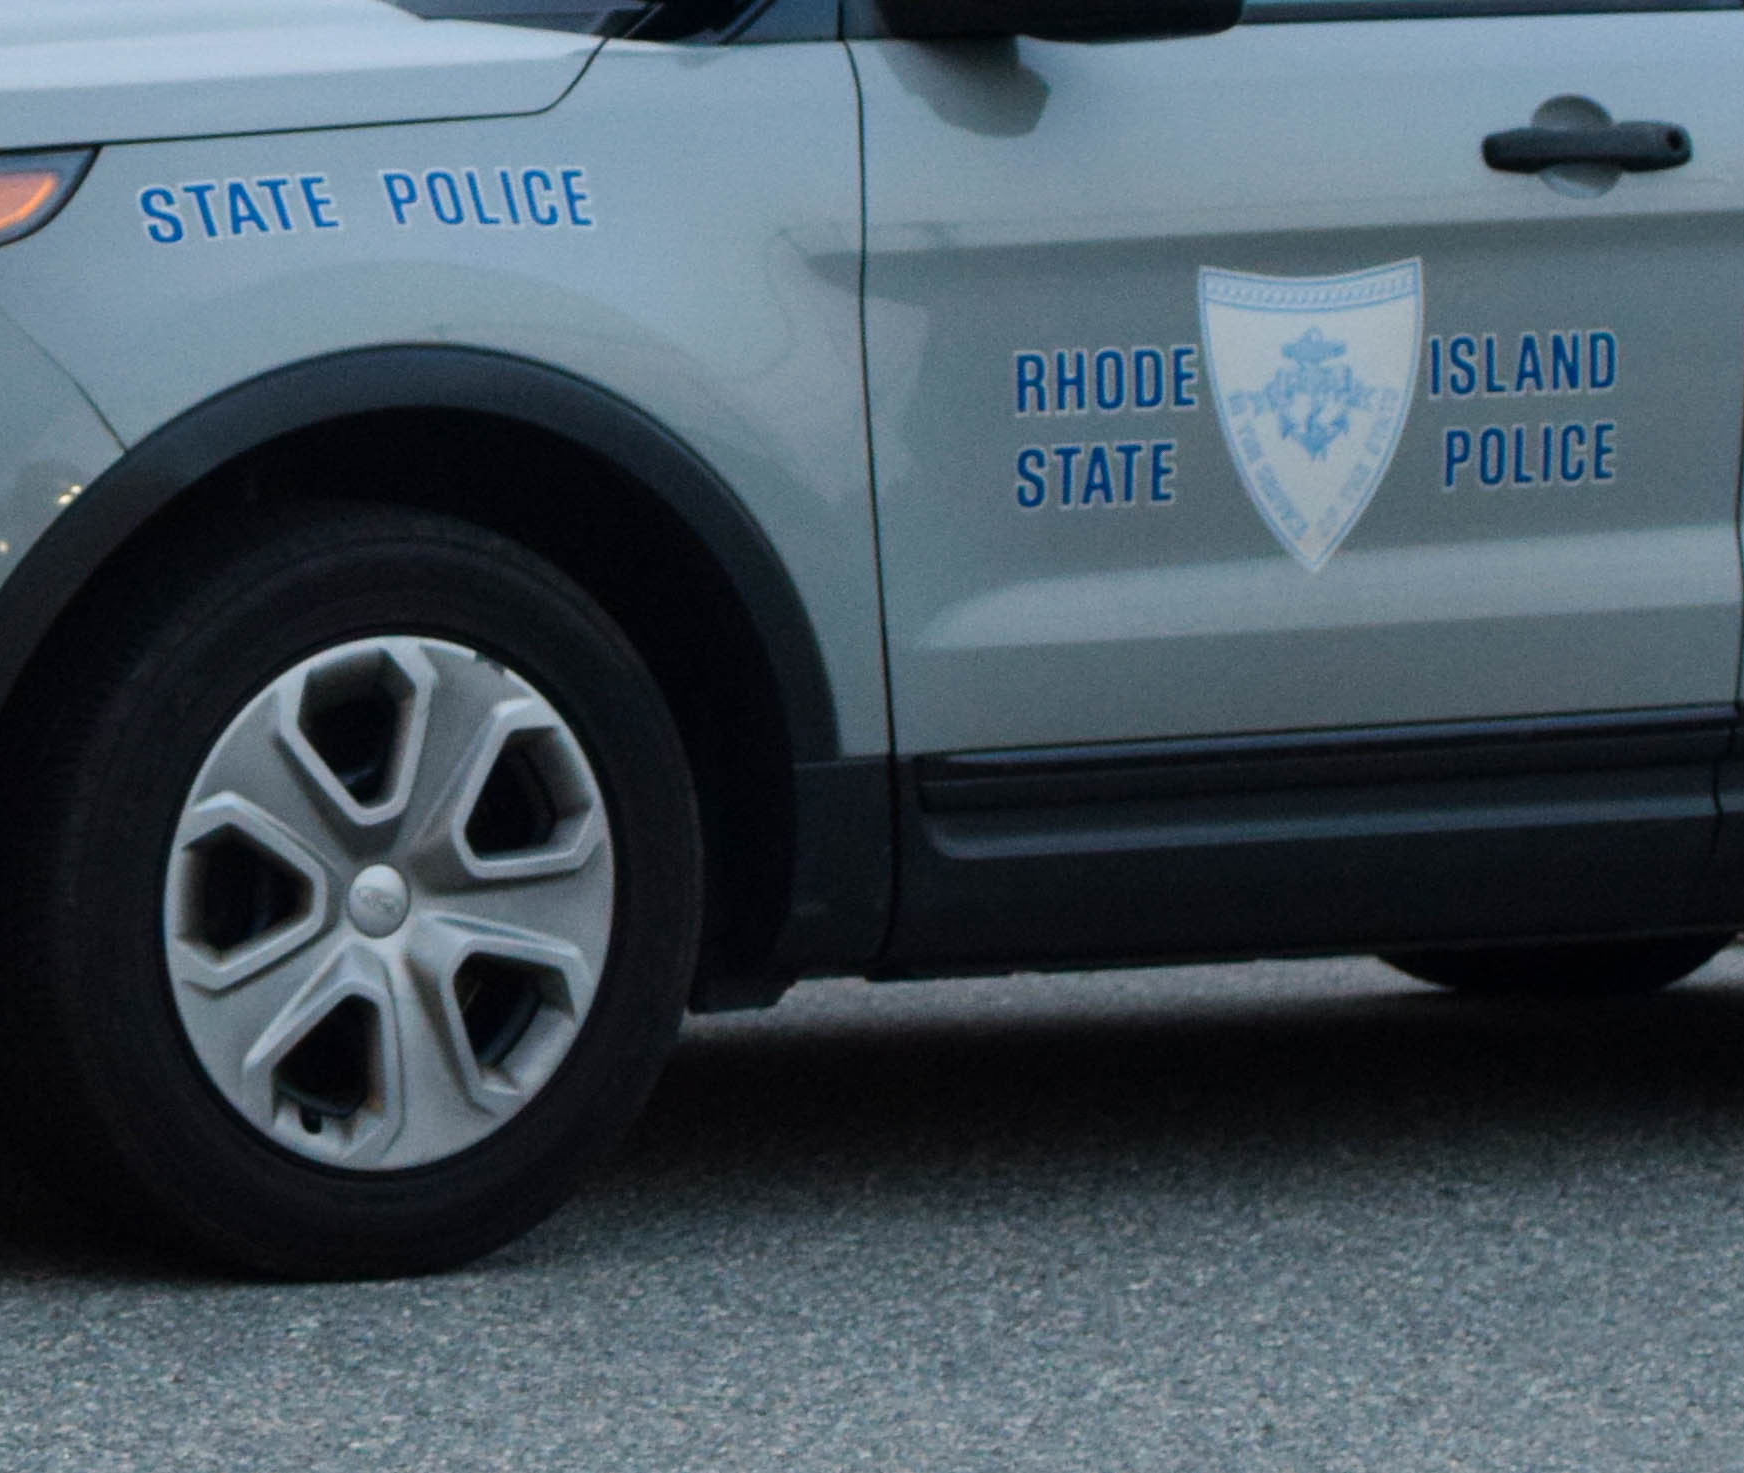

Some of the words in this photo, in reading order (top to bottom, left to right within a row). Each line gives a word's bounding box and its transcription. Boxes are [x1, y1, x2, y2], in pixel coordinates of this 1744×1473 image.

[138, 173, 340, 245] STATE
[380, 166, 594, 228] POLICE
[1014, 346, 1196, 413] RHODE
[1429, 329, 1617, 396] ISLAND
[1015, 441, 1174, 509] STATE
[1444, 421, 1615, 486] POLICE
